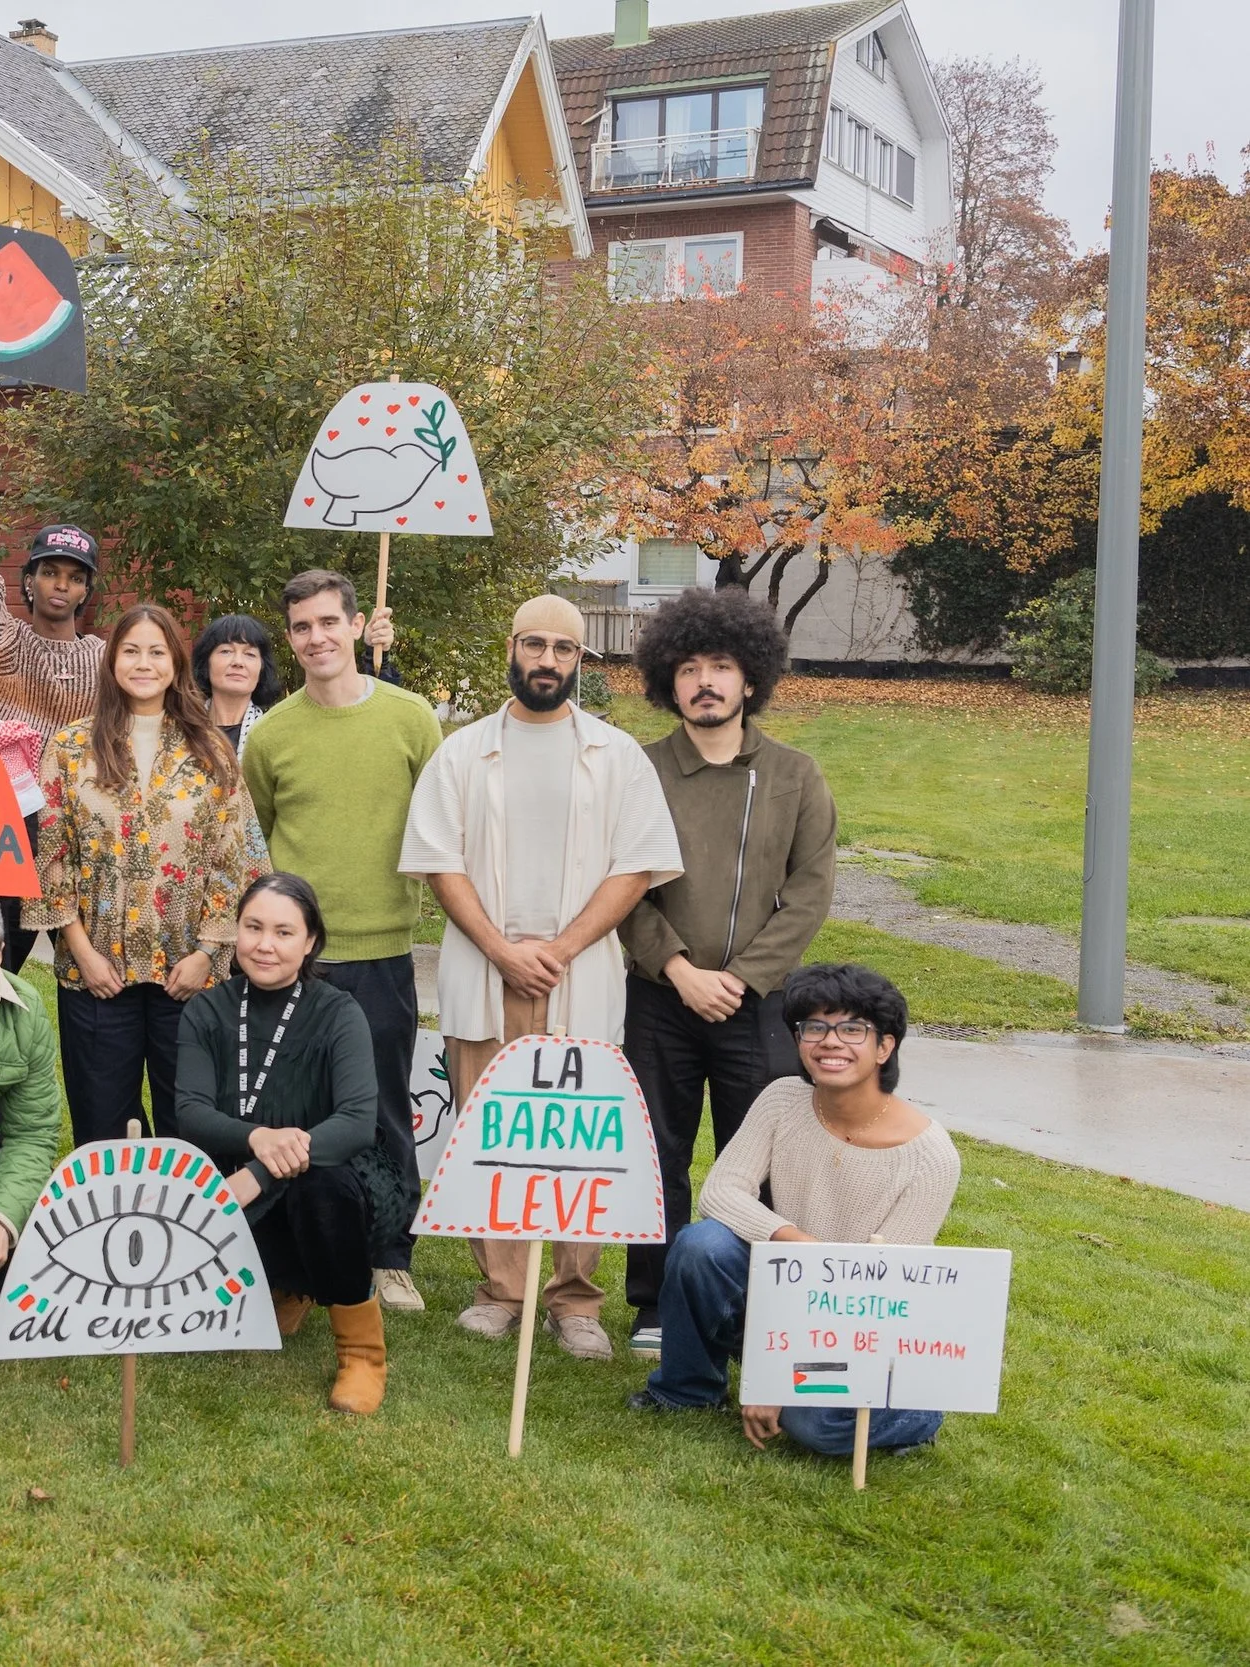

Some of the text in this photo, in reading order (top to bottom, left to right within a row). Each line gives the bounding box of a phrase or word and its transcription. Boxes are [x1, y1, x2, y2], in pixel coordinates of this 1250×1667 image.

[532, 1046, 584, 1091] LA
[481, 1101, 624, 1152] BARNA
[489, 1172, 613, 1235] LEVE
[767, 1257, 959, 1285] TO STAND WITH
[9, 1294, 247, 1350] all eyes on!
[807, 1289, 909, 1319] PALESTINE
[765, 1329, 966, 1360] IS TO BE HUMAN
